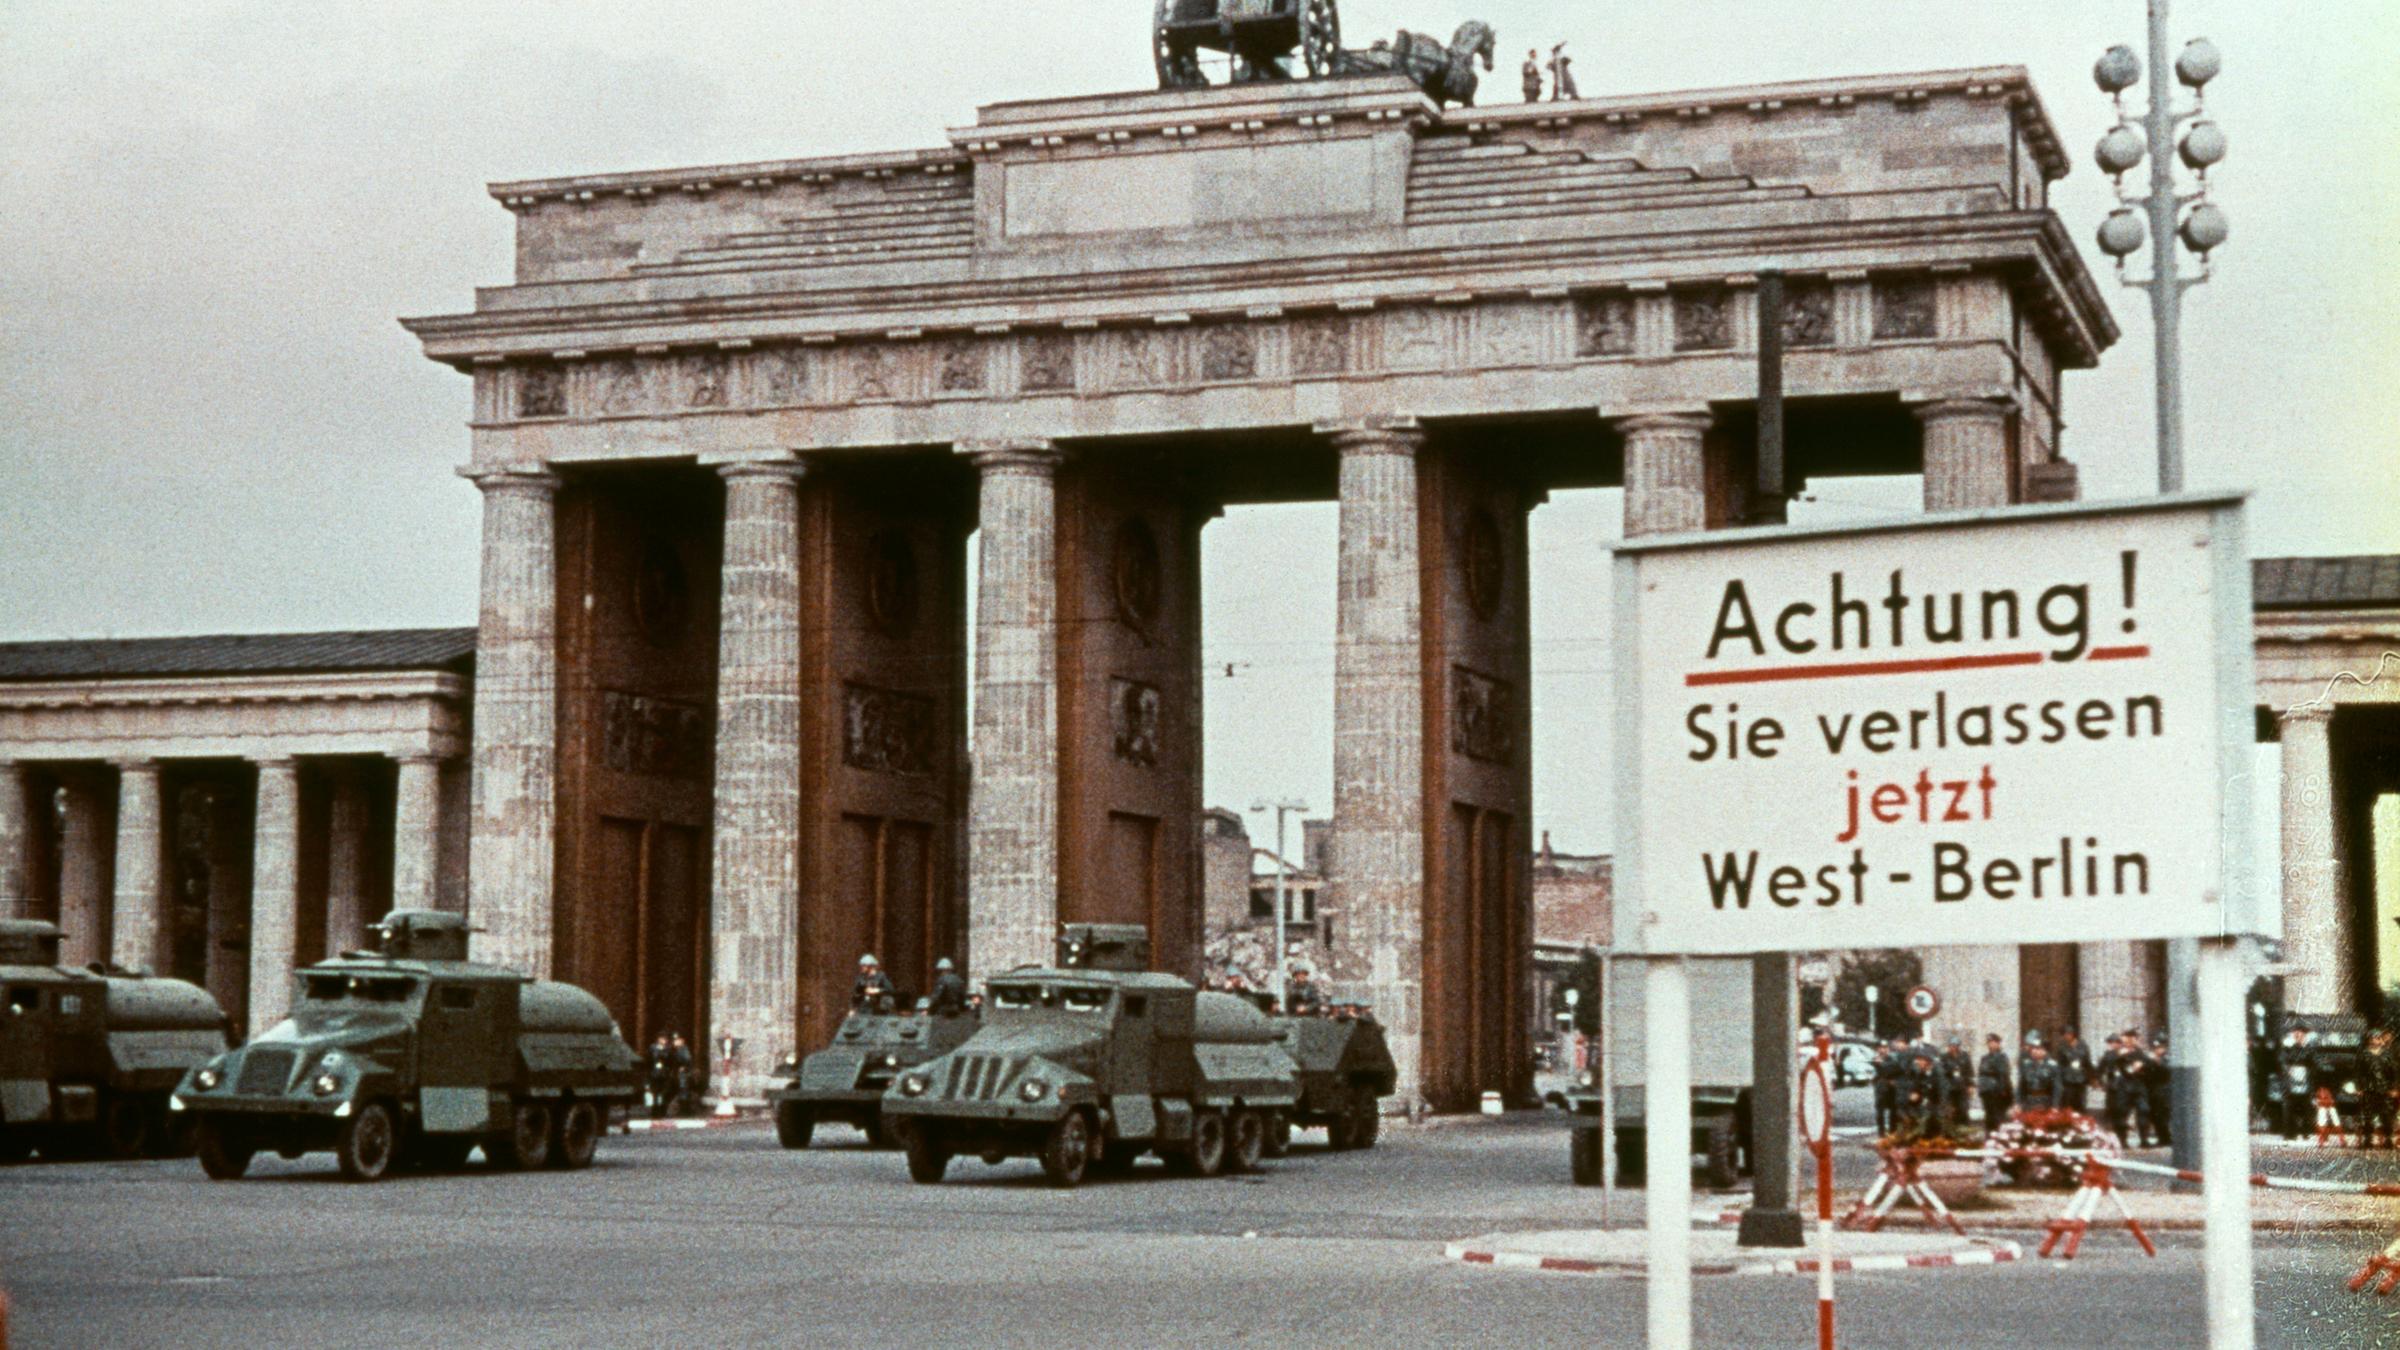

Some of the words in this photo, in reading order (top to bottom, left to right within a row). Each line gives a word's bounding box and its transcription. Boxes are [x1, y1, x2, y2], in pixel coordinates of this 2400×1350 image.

[1685, 702, 1785, 762] Sie
[1817, 690, 2163, 756] verlassen
[1836, 764, 1998, 844] jetzt
